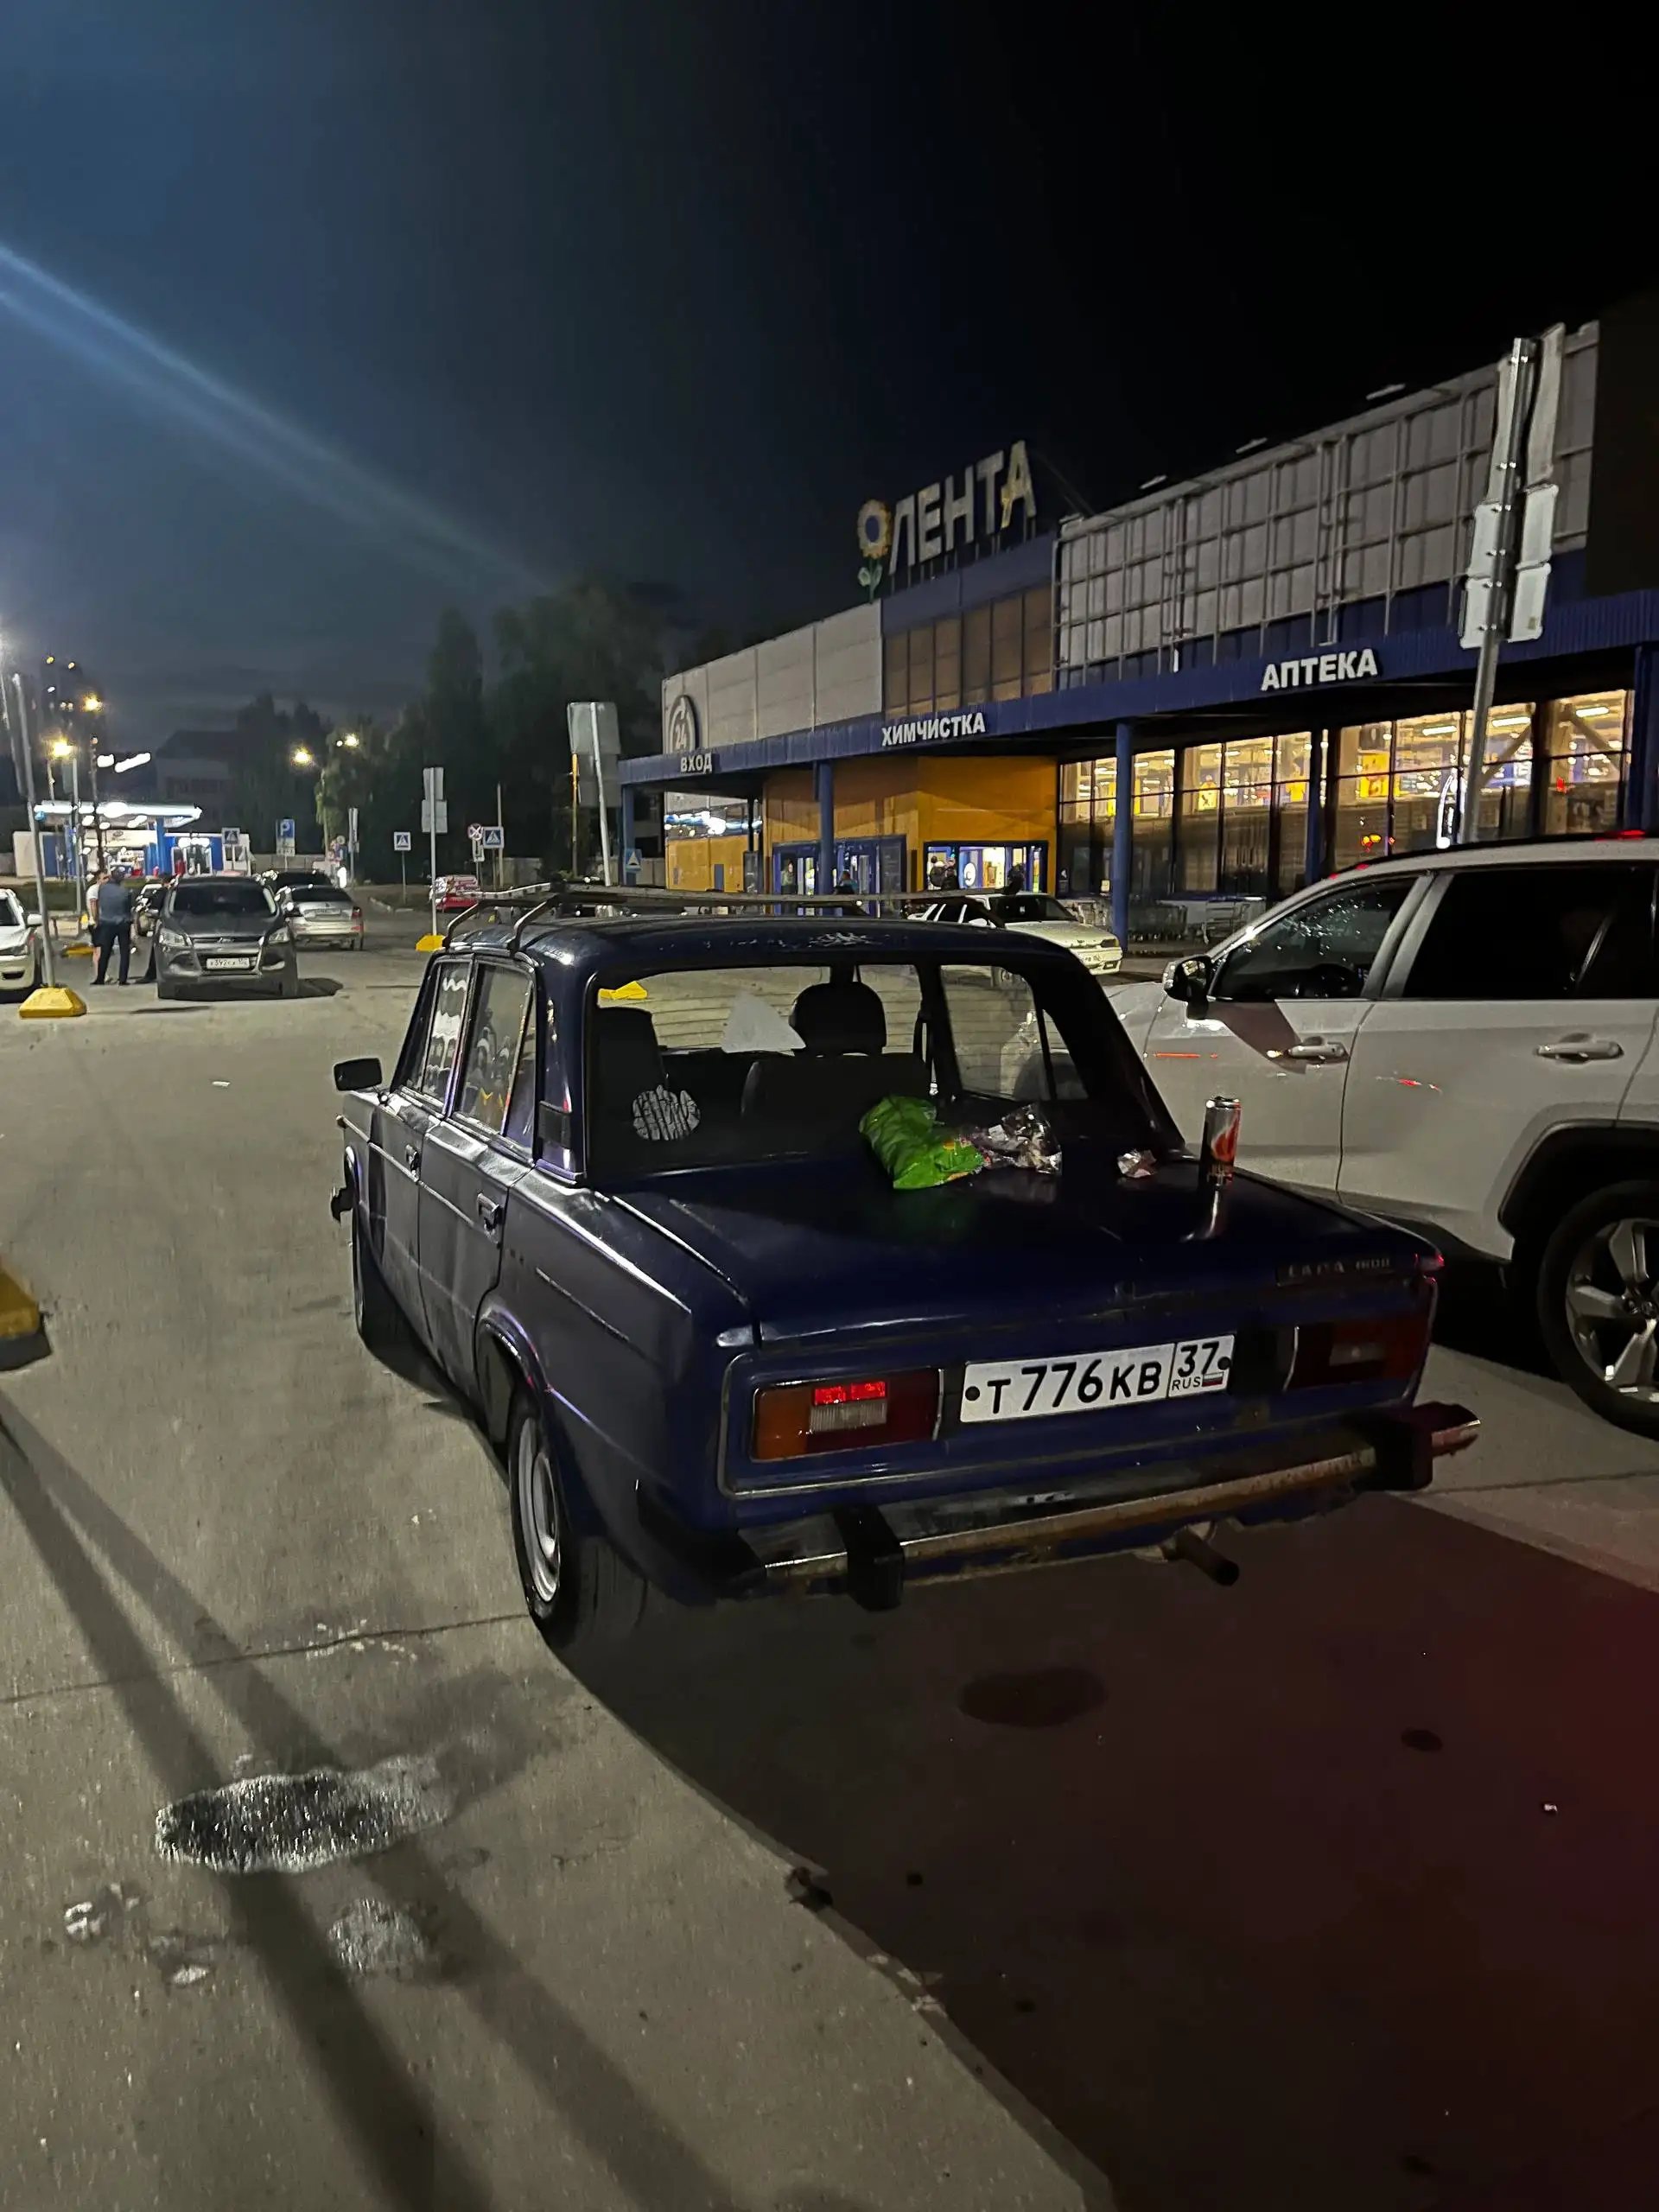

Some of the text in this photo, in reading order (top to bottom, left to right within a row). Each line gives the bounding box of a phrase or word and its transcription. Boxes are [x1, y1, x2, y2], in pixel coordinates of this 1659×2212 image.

[889, 440, 1036, 575] ЛЕНТА
[1261, 648, 1378, 691] АПТЕКА
[675, 724, 688, 750] 24
[881, 712, 986, 747] ХИМЧИСТКА
[680, 752, 713, 774] ВХОД
[1178, 1341, 1219, 1377] 37
[1171, 1376, 1201, 1390] RUS
